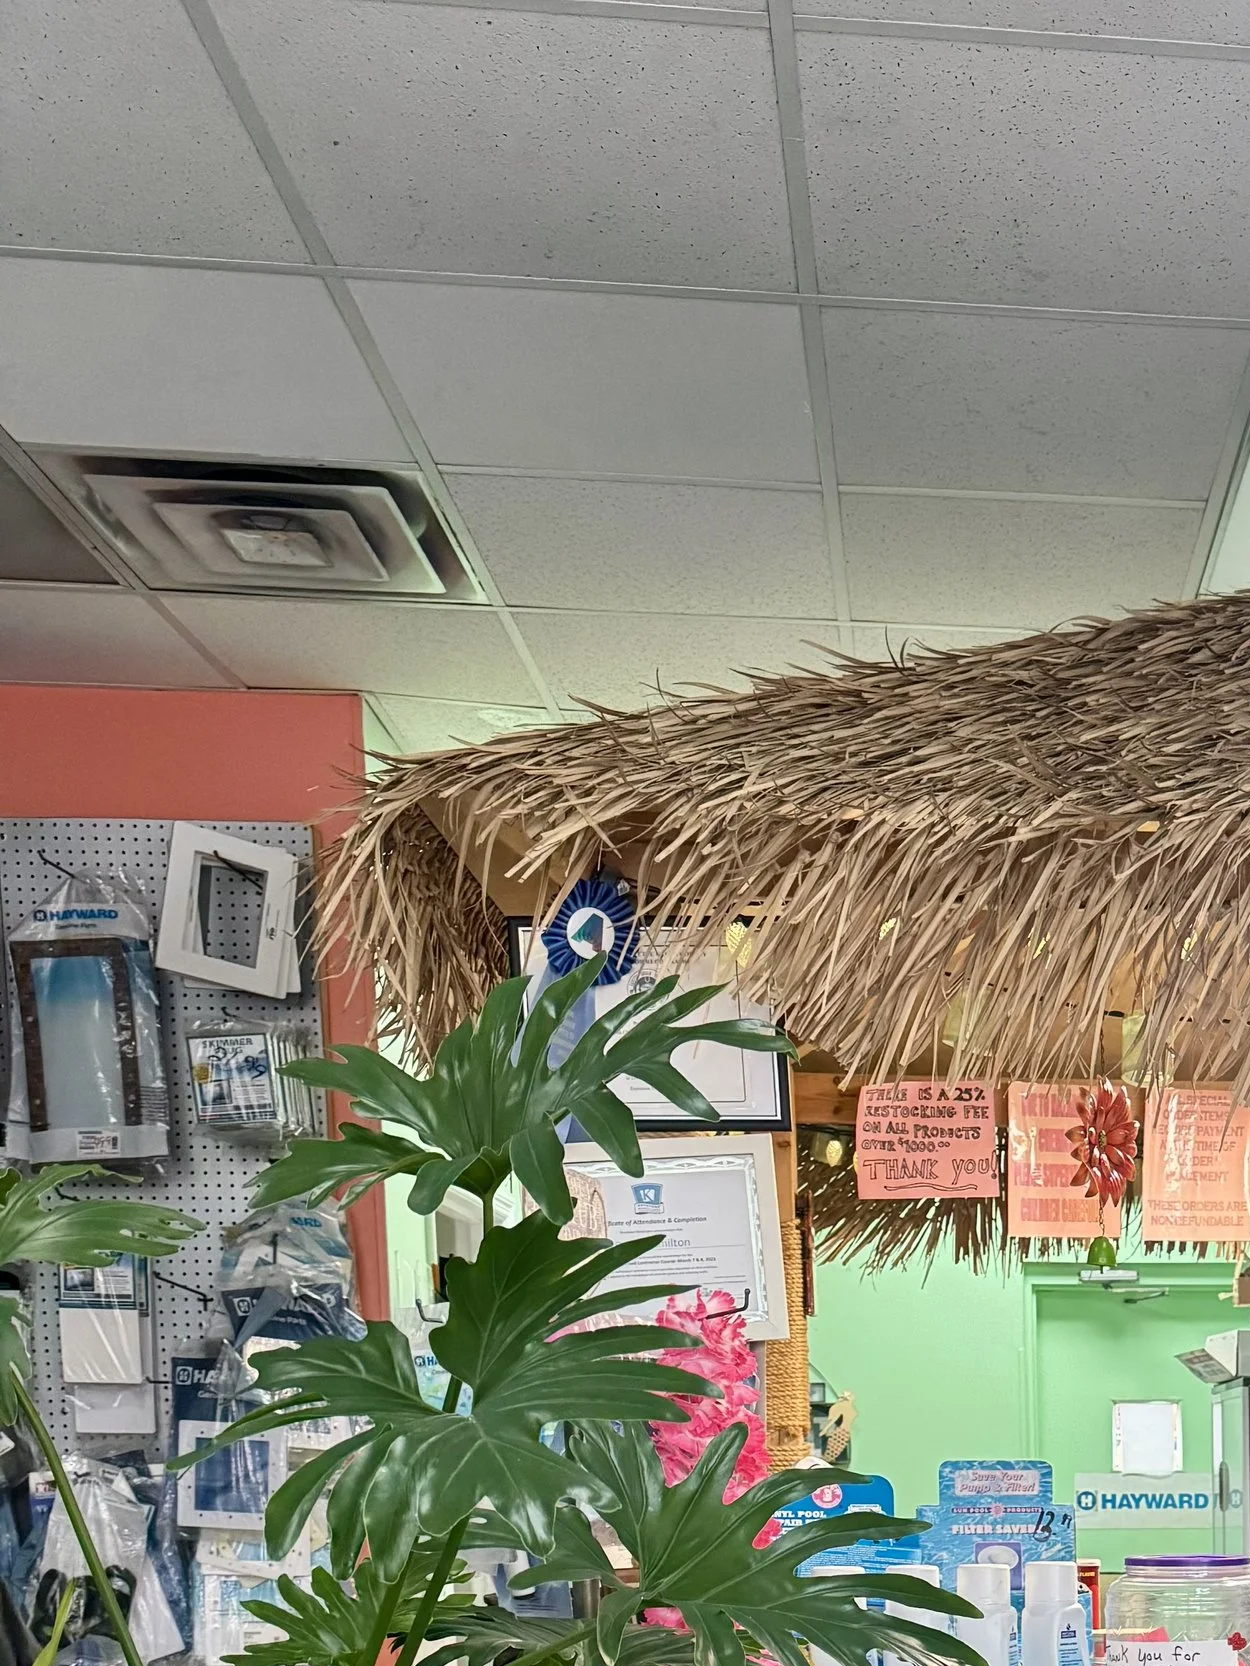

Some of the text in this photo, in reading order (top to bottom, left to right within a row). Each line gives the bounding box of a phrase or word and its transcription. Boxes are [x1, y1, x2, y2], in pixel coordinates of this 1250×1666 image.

[49, 908, 119, 921] HAYWARD
[202, 1037, 253, 1049] SKIMMER
[918, 1087, 932, 1100] IS
[937, 1088, 950, 1101] A
[953, 1086, 986, 1101] 25%
[864, 1105, 990, 1119] RESTOCKING FEE
[863, 1121, 981, 1139] ON ALL PRODUCTS
[1196, 1126, 1245, 1136] PAYMENT
[861, 1139, 897, 1151] OVER
[863, 1158, 938, 1180] THANK
[1182, 1200, 1224, 1211] ORDERS
[1226, 1200, 1248, 1212] ARE
[633, 1217, 666, 1226] Attendance
[673, 1215, 708, 1224] Completion
[971, 1471, 1024, 1482] Save Your
[960, 1483, 991, 1494] Pump
[1101, 1493, 1209, 1510] HAYWARD
[797, 1510, 827, 1518] POOL
[951, 1524, 993, 1535] FILTER
[1172, 1645, 1201, 1662] for
